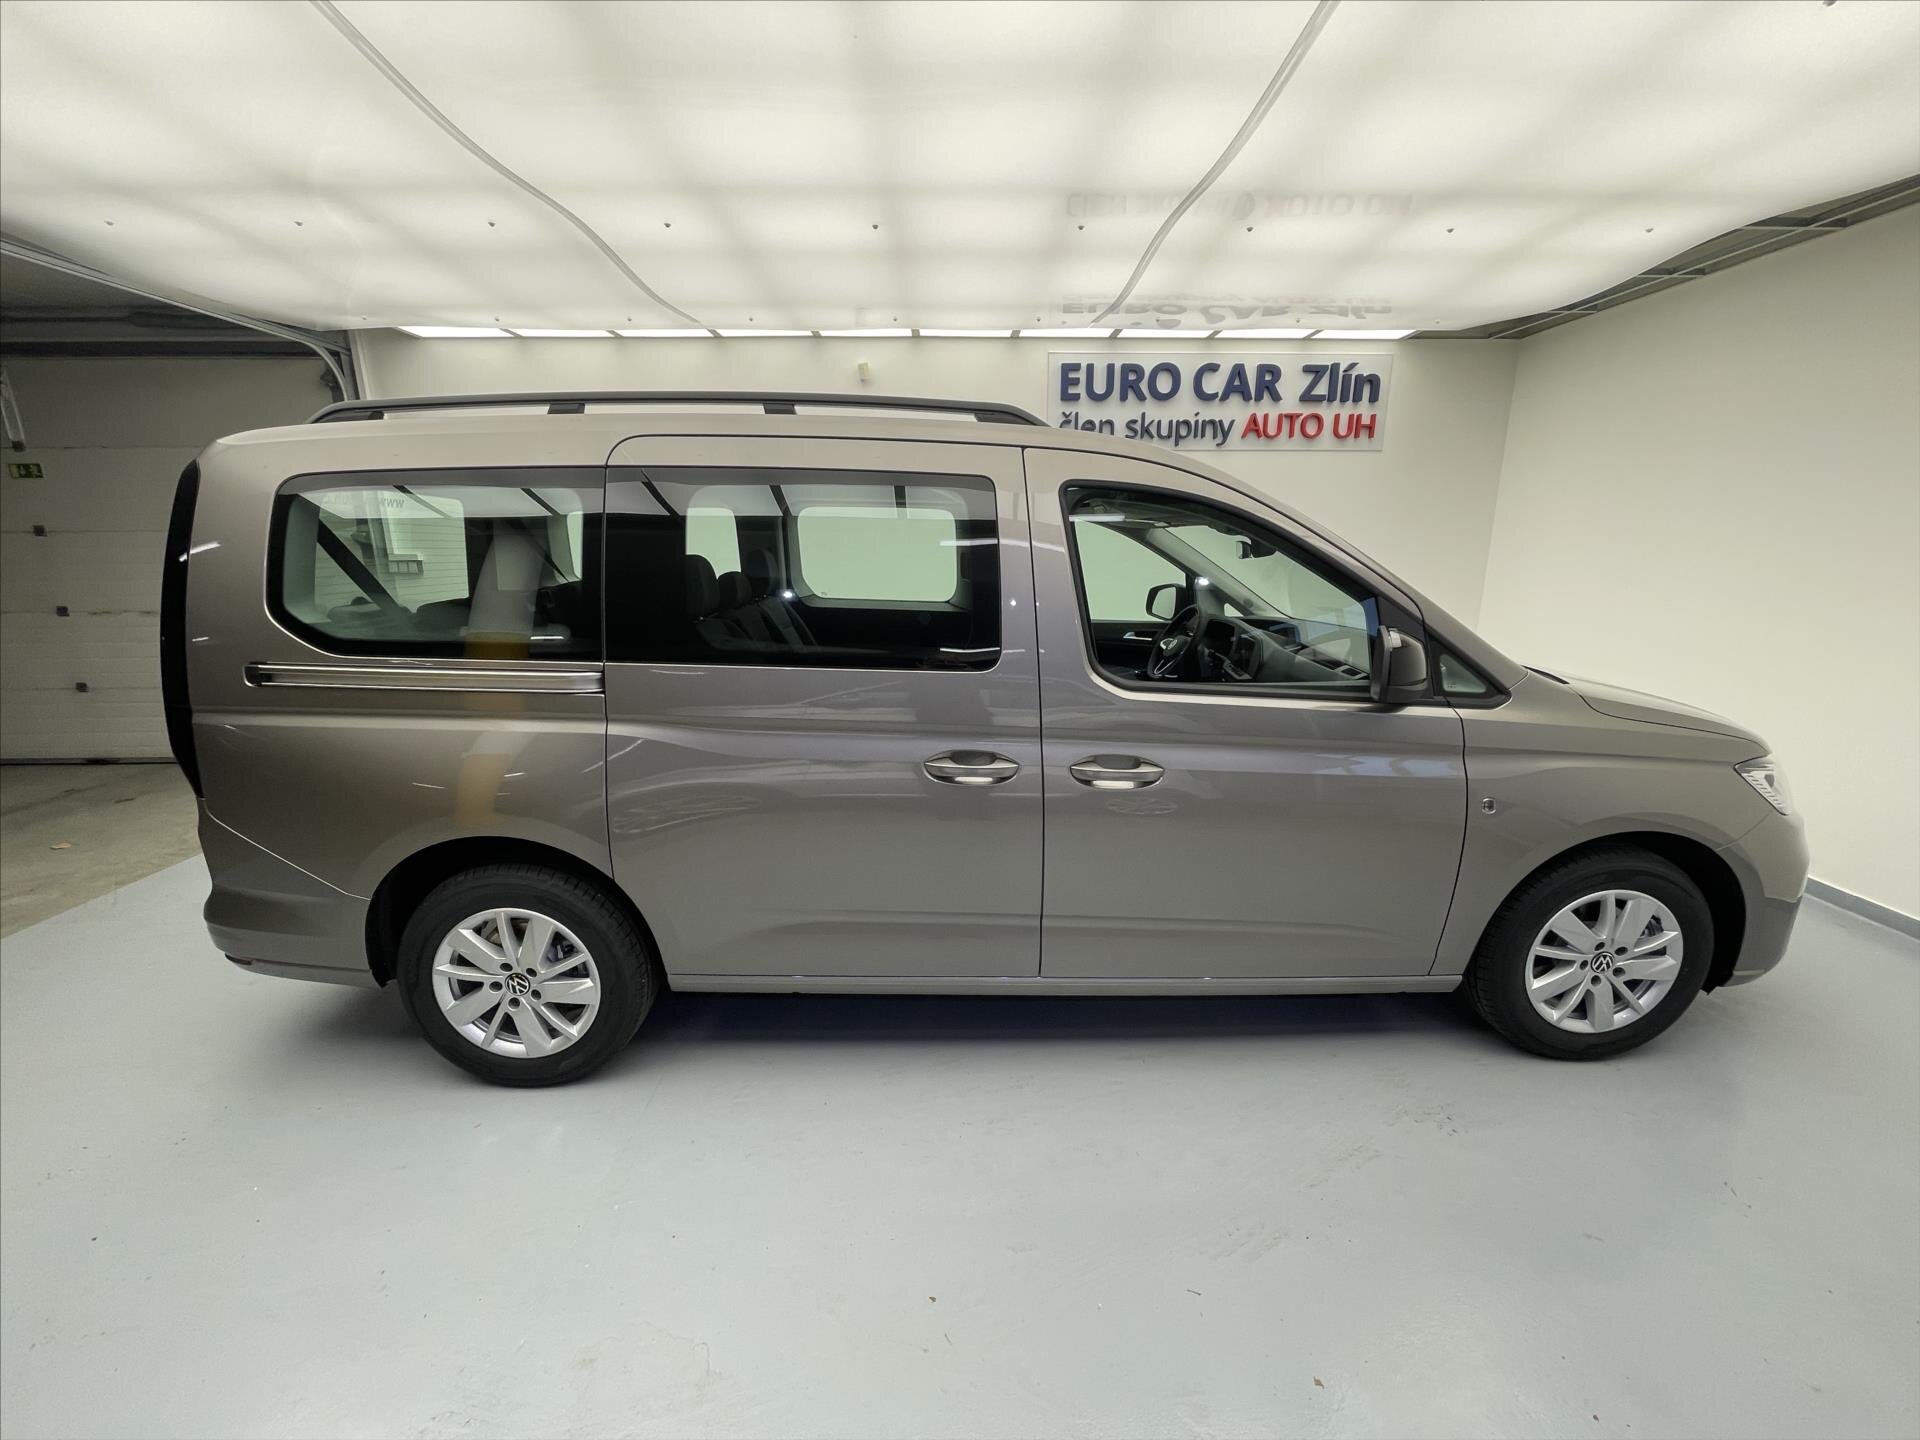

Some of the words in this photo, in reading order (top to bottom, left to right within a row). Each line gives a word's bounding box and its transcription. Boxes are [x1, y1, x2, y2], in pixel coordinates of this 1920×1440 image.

[1060, 362, 1182, 402] EURO
[1193, 362, 1283, 403] CAR
[1299, 361, 1381, 404] Zlín
[1059, 411, 1115, 436] člen
[1124, 411, 1235, 447] skupiny
[1241, 412, 1325, 440] AUTO
[1332, 413, 1377, 440] UH
